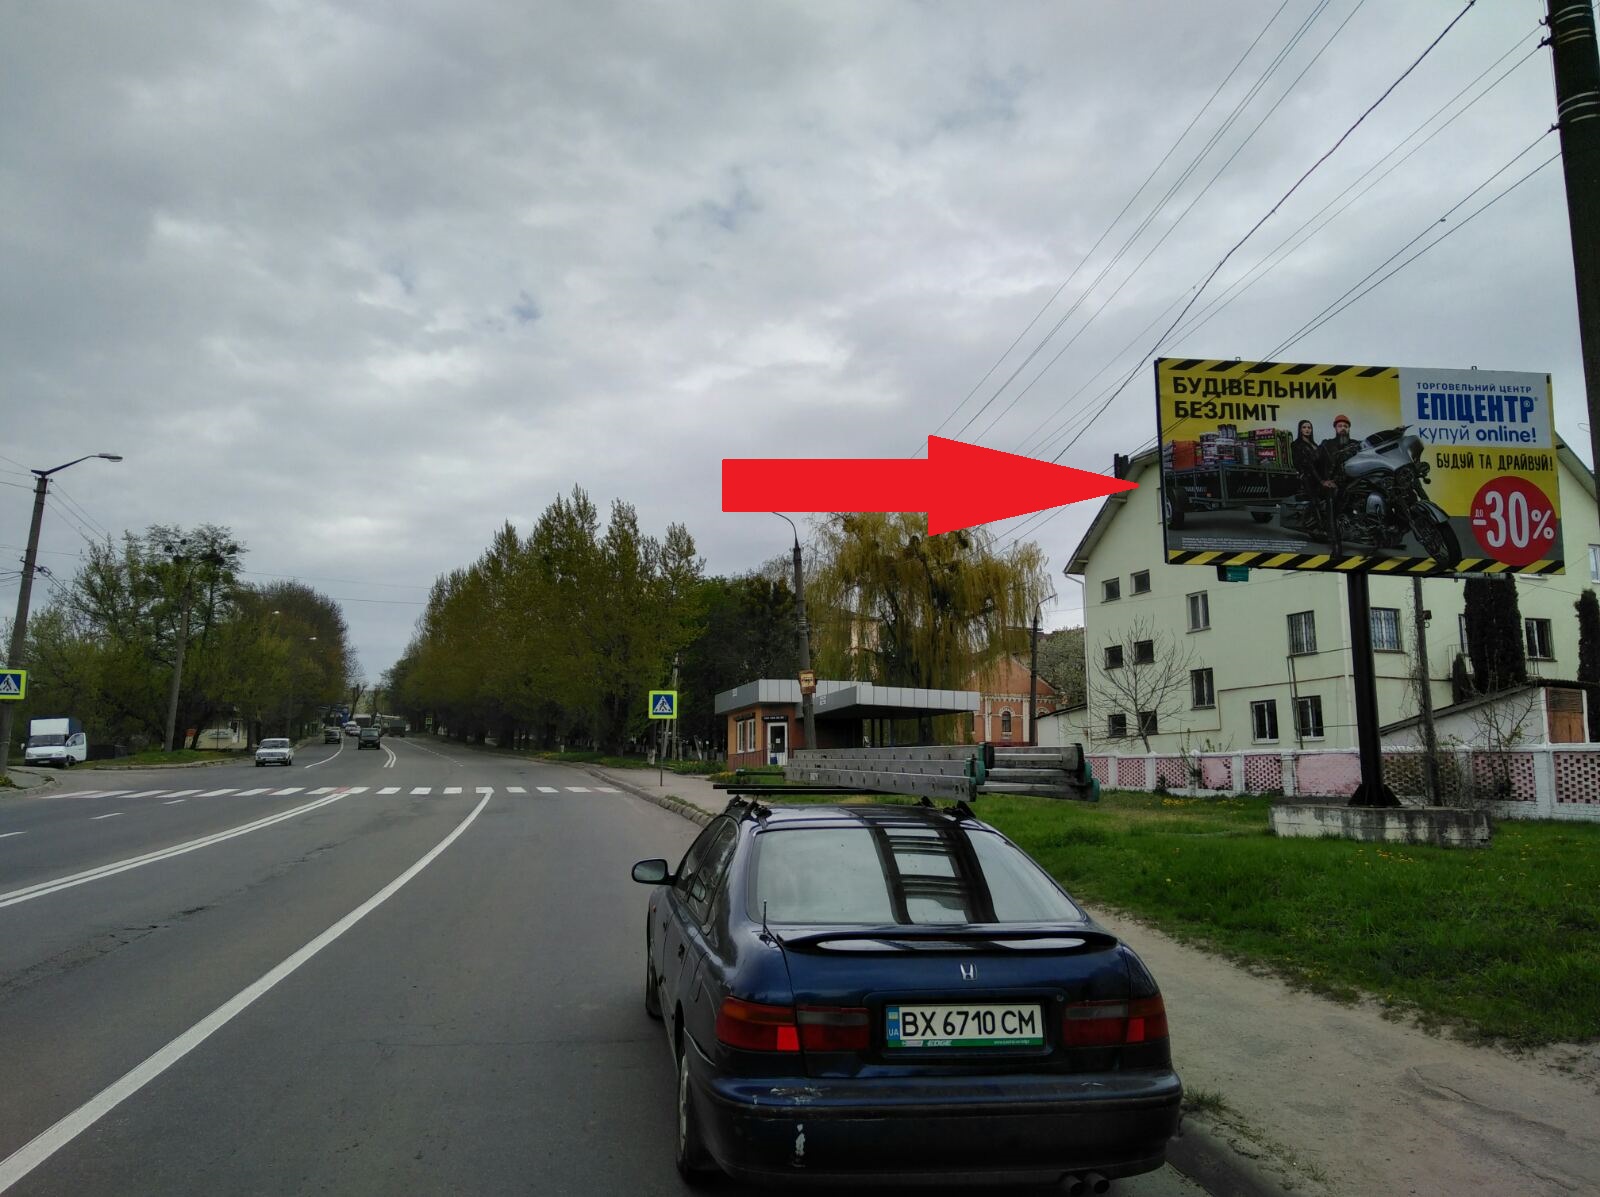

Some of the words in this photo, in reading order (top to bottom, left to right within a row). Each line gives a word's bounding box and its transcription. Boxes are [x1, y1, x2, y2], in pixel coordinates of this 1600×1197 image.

[1173, 376, 1337, 399] БУДІВЕЛЬНИЙ
[1417, 382, 1496, 392] ТОРГОВЕЛЬНИЙ
[1499, 384, 1532, 394] ЦЕНТР
[1174, 400, 1280, 421] БЕЗЛІМІТ
[1417, 392, 1534, 423] ЕПІЦЕНТР
[1418, 425, 1470, 444] купуй
[1475, 425, 1537, 443] online!
[1436, 452, 1474, 470] БУДУЙ
[1479, 454, 1493, 469] ТА
[1497, 454, 1553, 472] ДРАЙВУЙ!
[1472, 490, 1554, 548] -30%
[888, 1029, 899, 1037] UA
[901, 1011, 937, 1036] BX
[942, 1010, 996, 1035] 6710
[1001, 1010, 1036, 1035] CM
